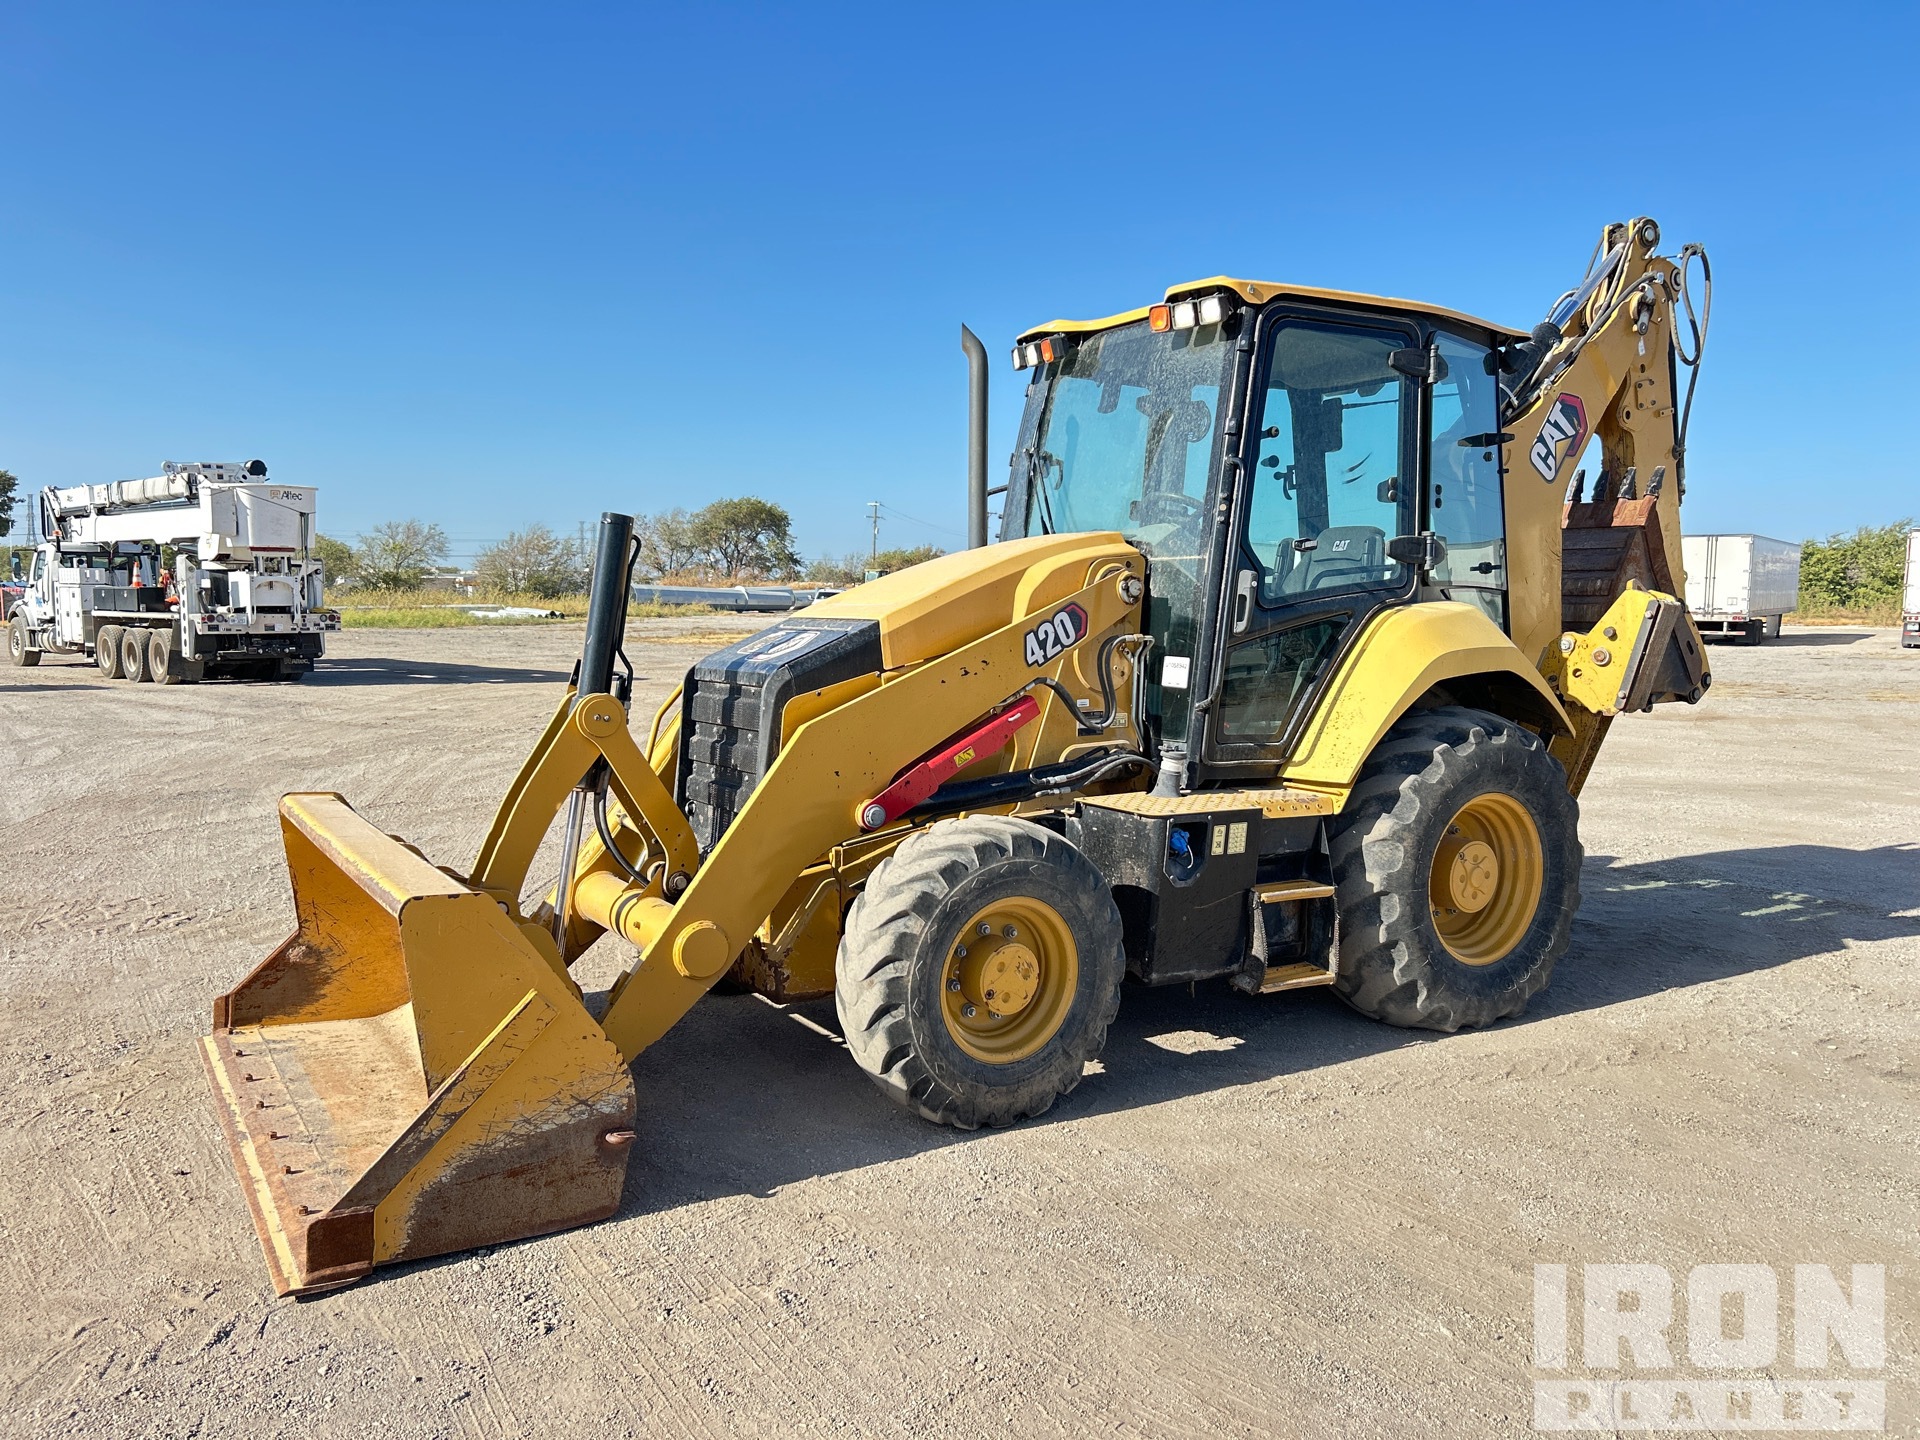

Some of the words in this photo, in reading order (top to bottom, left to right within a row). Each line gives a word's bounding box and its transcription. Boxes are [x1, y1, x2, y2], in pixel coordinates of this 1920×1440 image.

[1531, 401, 1576, 481] CAT
[281, 490, 302, 501] Altec
[1332, 539, 1351, 552] CAT
[1026, 611, 1076, 665] 420
